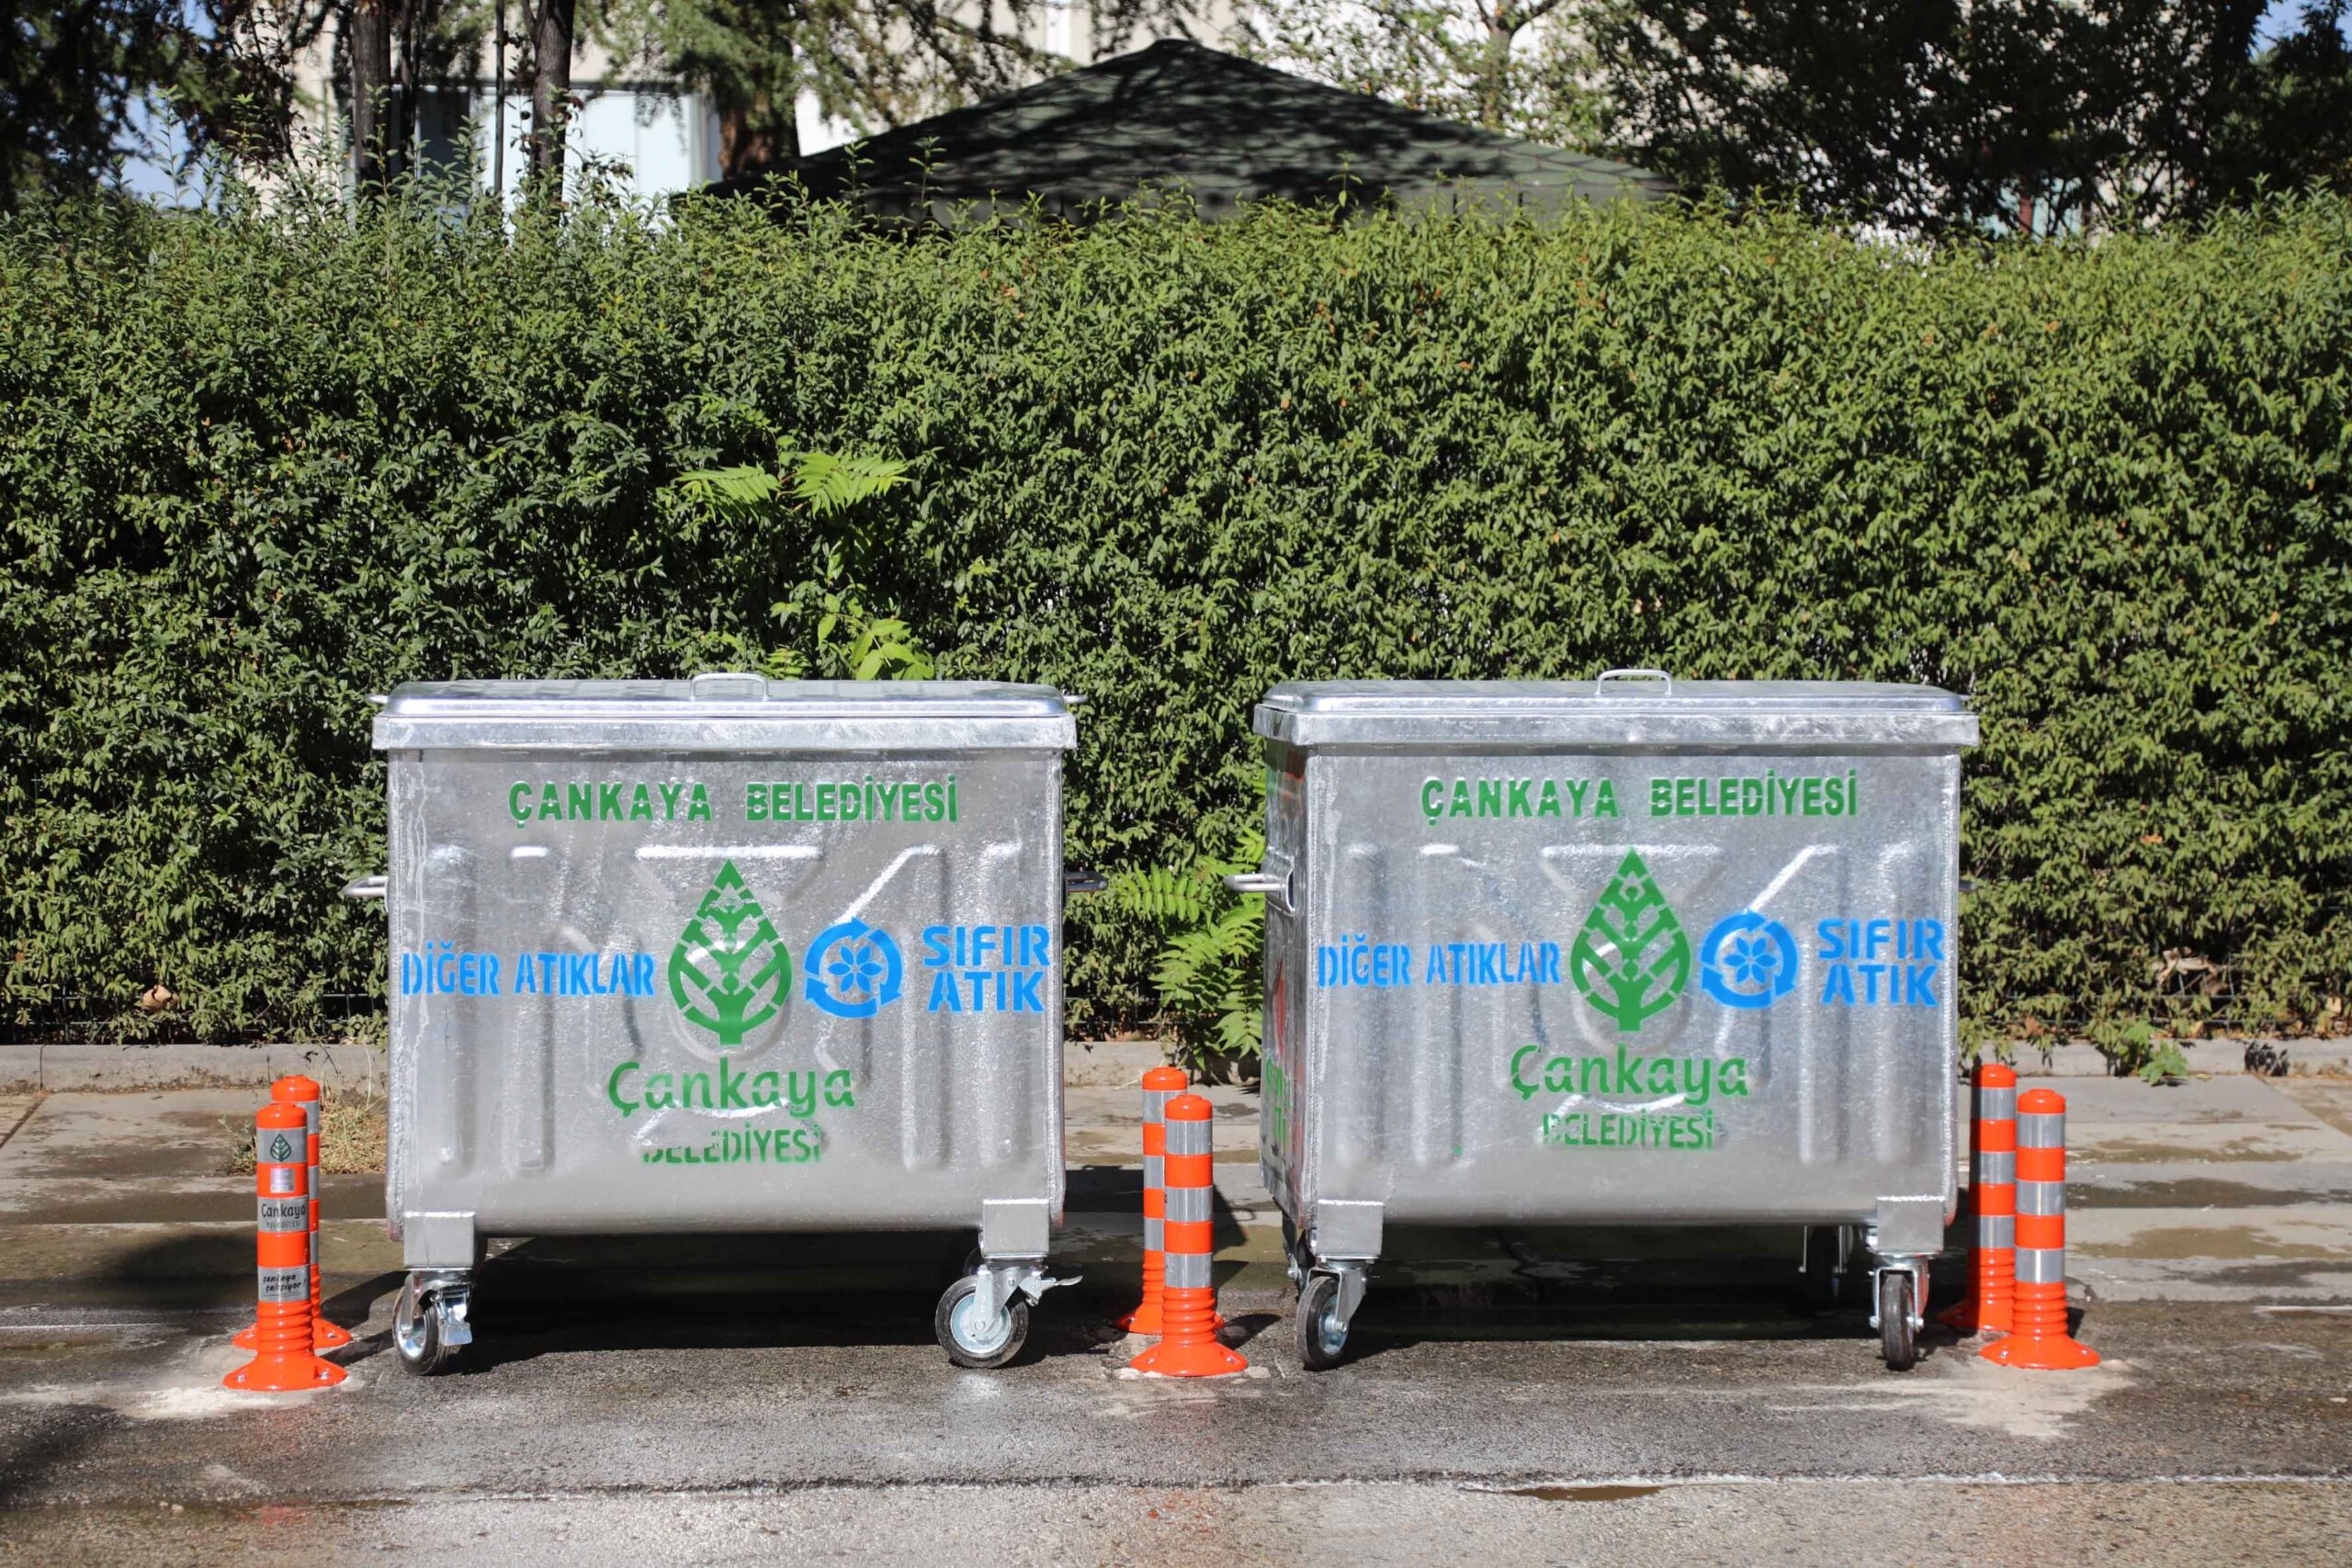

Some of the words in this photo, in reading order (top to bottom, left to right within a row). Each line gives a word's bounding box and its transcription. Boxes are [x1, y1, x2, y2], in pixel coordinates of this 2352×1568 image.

[509, 781, 713, 829] ÇANKAYA
[747, 775, 958, 823] BELEDİYESİ
[1421, 778, 1620, 826] ÇANKAYA
[1650, 769, 1859, 818] BELEDİYESİ
[923, 925, 1050, 968] SIFIR
[1318, 935, 1412, 989] DİĞER
[1426, 942, 1562, 987] ATIKLAR
[1818, 919, 1945, 962] SIFIR
[402, 941, 501, 997] DİĞER
[514, 952, 655, 997] ATIKLAR
[928, 970, 1046, 1013] ATIK
[1823, 964, 1939, 1008] ATIK
[607, 1058, 855, 1119] Çankaya
[1510, 1042, 1749, 1108] Çankaya
[261, 1203, 306, 1219] Çankaya
